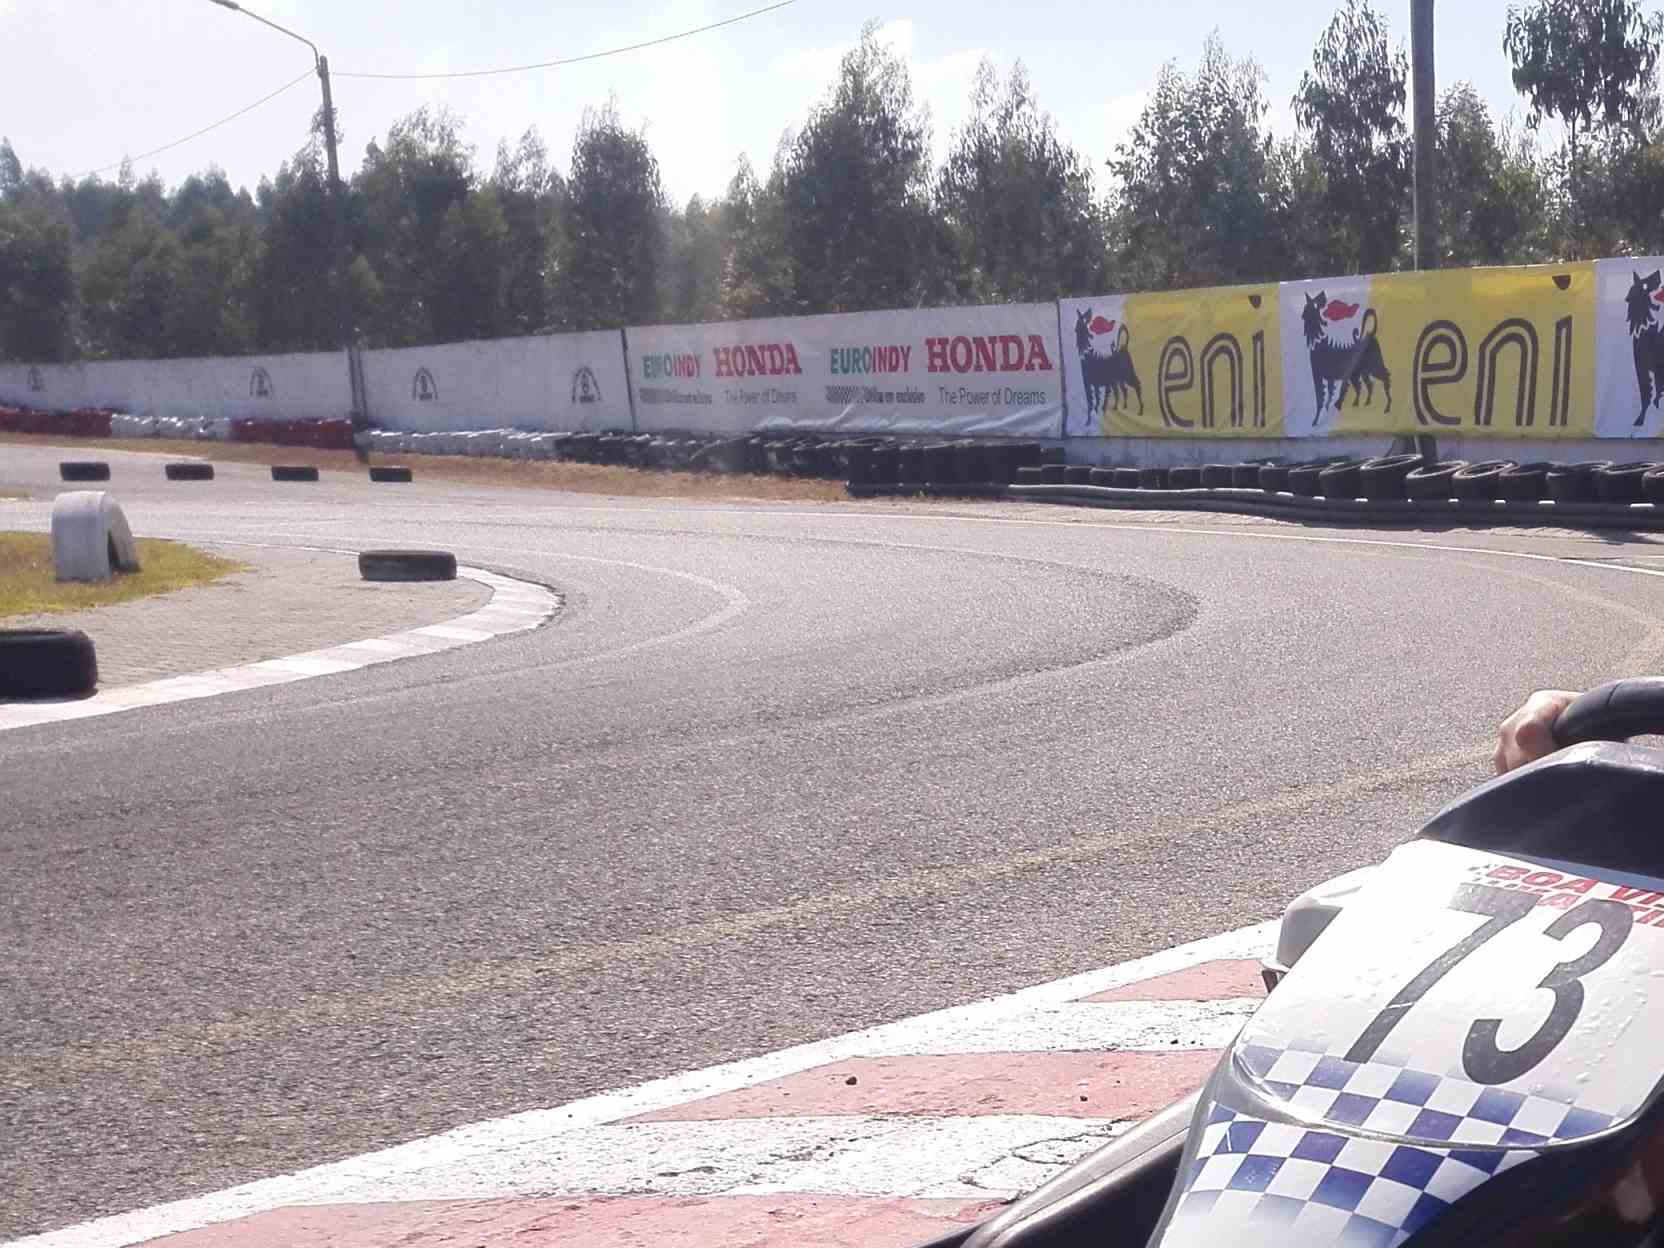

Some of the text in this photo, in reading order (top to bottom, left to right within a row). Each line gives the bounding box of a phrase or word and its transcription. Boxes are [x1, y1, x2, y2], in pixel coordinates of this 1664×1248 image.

[713, 343, 802, 377] HONDA
[830, 334, 1053, 375] EUROINDY HONDA
[1157, 294, 1265, 429] eni
[1412, 275, 1573, 427] eni
[1486, 864, 1600, 894] BOA
[1343, 882, 1635, 1086] 73
